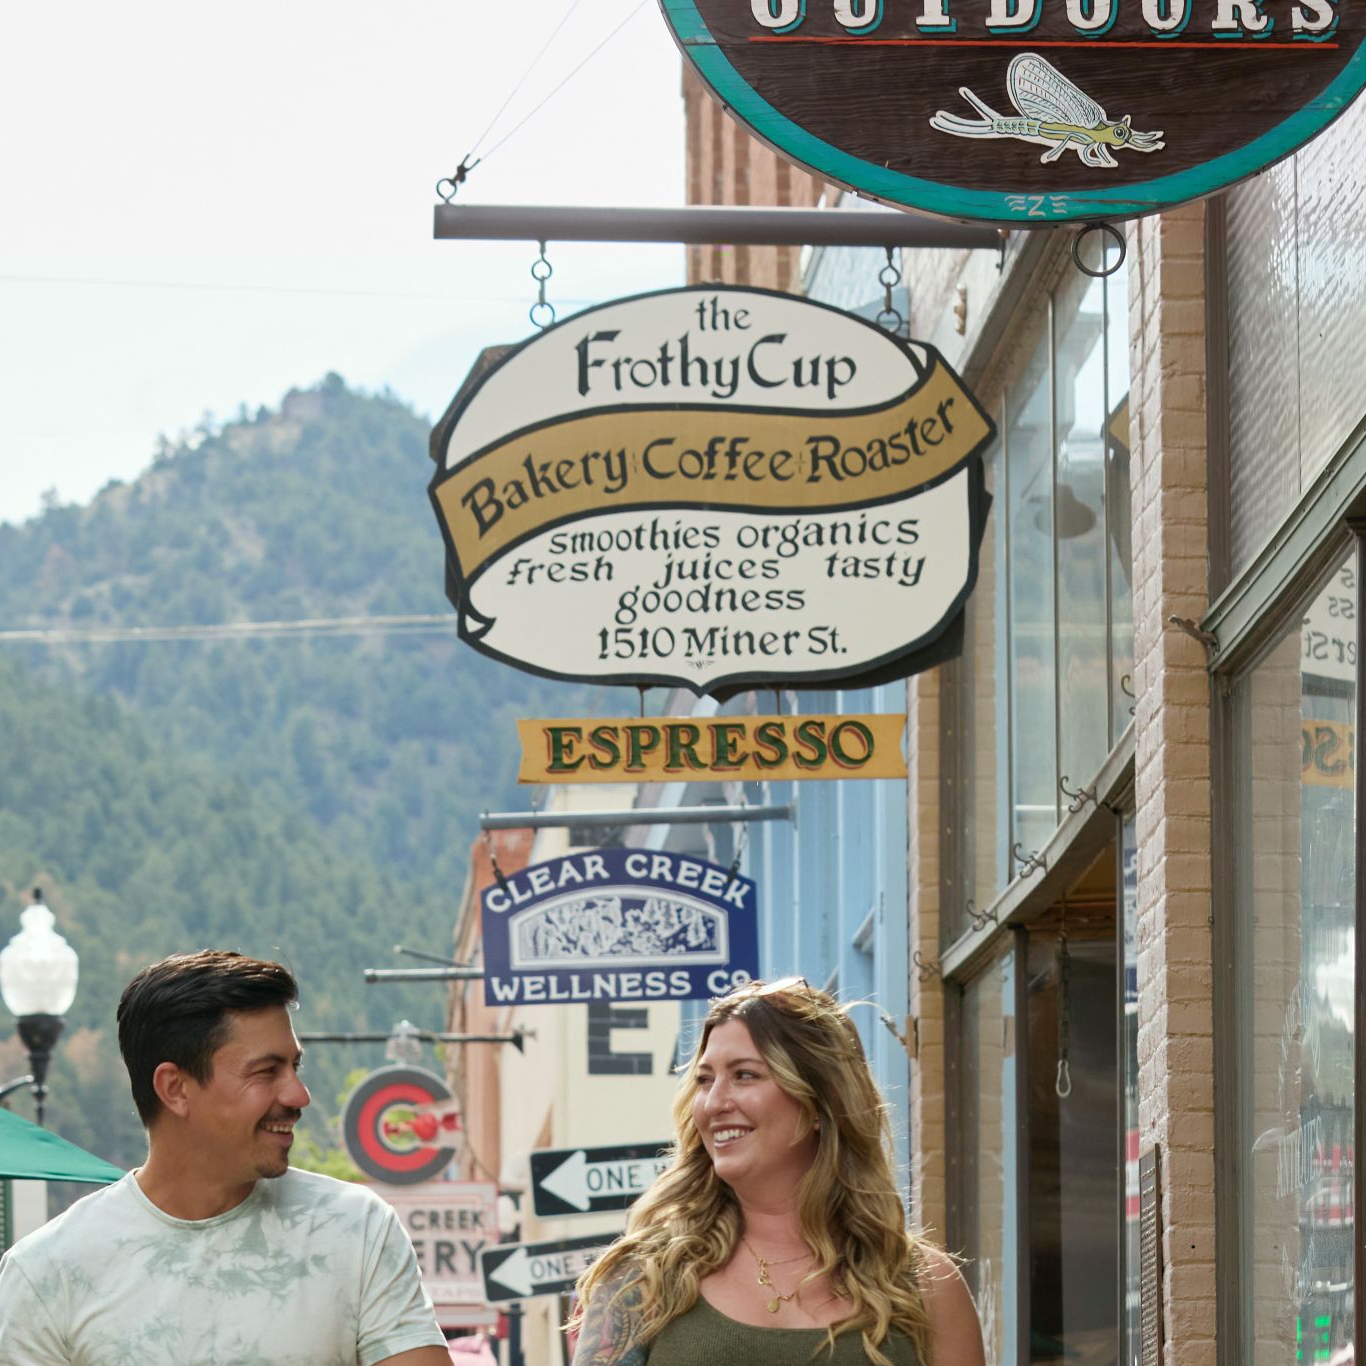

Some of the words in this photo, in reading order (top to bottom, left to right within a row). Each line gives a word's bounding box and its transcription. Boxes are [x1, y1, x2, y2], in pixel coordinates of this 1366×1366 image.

[695, 296, 752, 332] the
[574, 330, 741, 399] Frothy
[746, 333, 858, 400] Cup
[460, 447, 630, 540] Bakery
[643, 436, 795, 484] Coffee
[805, 396, 956, 484] Roaster
[548, 519, 722, 555] smoothies
[736, 513, 921, 558] organics
[506, 556, 614, 586] fresh
[654, 552, 780, 589] juices
[825, 551, 926, 586] tasty
[615, 584, 806, 626] goodness
[598, 626, 675, 660] 1510
[682, 625, 800, 658] Miner
[807, 625, 848, 655] St.
[543, 719, 875, 775] ESPRESSO
[485, 855, 611, 913] CLEAR
[625, 853, 751, 909] CREEK
[490, 971, 692, 1002] WELLNESS
[1276, 1115, 1322, 1201] ANTIQUES
[586, 1164, 638, 1193] ONE
[408, 1210, 485, 1231] CREEK
[530, 1253, 576, 1281] ONE
